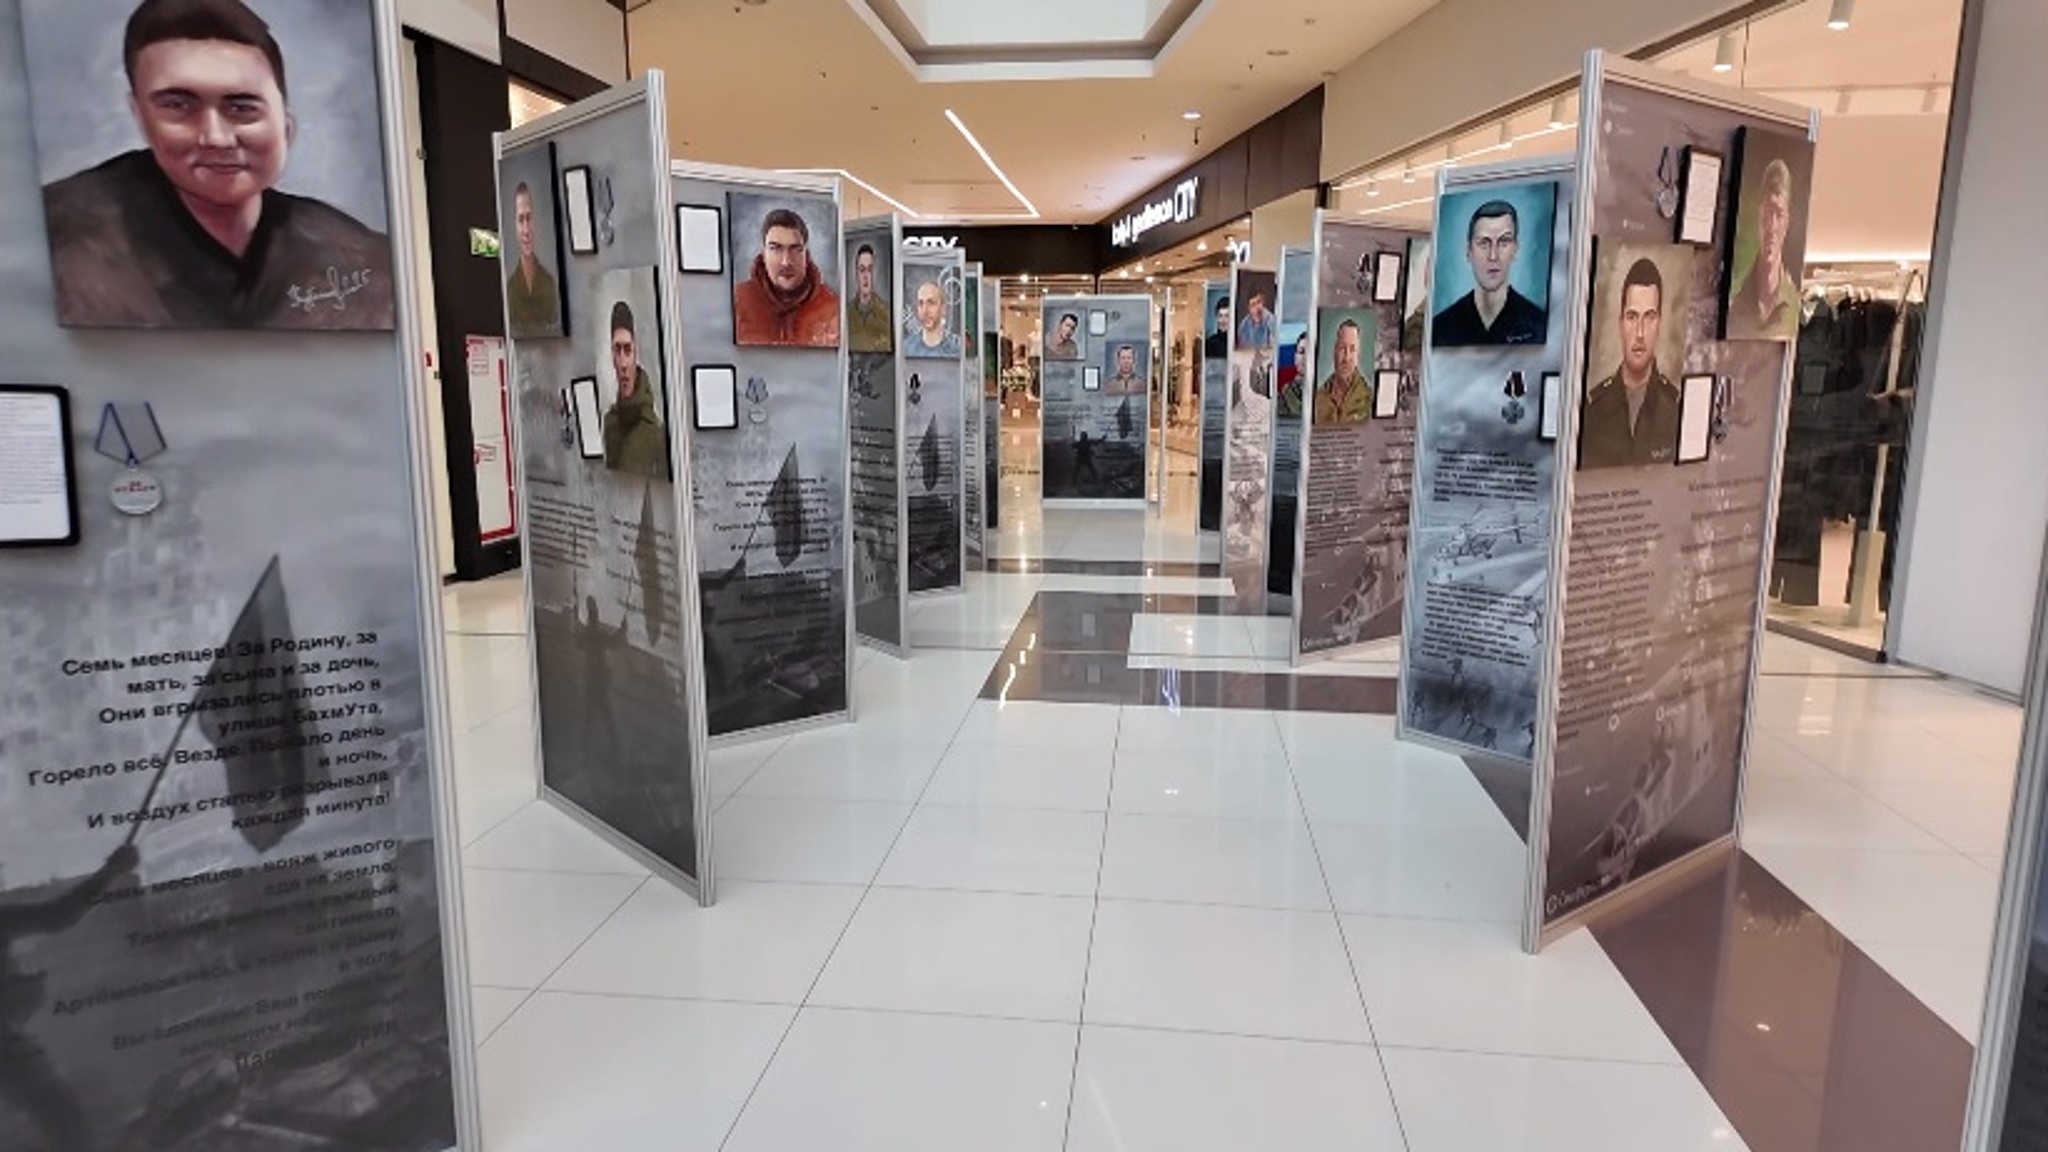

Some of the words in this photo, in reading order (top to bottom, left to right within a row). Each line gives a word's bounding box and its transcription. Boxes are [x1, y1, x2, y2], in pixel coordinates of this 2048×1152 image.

[61, 658, 126, 677] Семь
[131, 642, 231, 667] месяцев!
[238, 640, 265, 656] За
[271, 635, 352, 654] Родину,
[356, 631, 378, 645] за
[127, 677, 187, 694] мать,
[222, 667, 276, 684] сына
[282, 664, 295, 677] и
[299, 662, 321, 675] за
[327, 656, 380, 672] дочь,
[99, 707, 146, 725] Они
[288, 679, 365, 700] плотью
[370, 677, 382, 691] в
[218, 716, 286, 738] улицы
[28, 761, 117, 787] Горело
[339, 726, 386, 744] день
[319, 756, 330, 769] и
[336, 749, 388, 767] ночь,
[87, 812, 104, 830] И
[110, 801, 190, 827] воздух
[196, 788, 275, 811] сталью
[231, 805, 311, 830] каждая
[316, 790, 390, 817] минута!
[323, 838, 396, 861] живого
